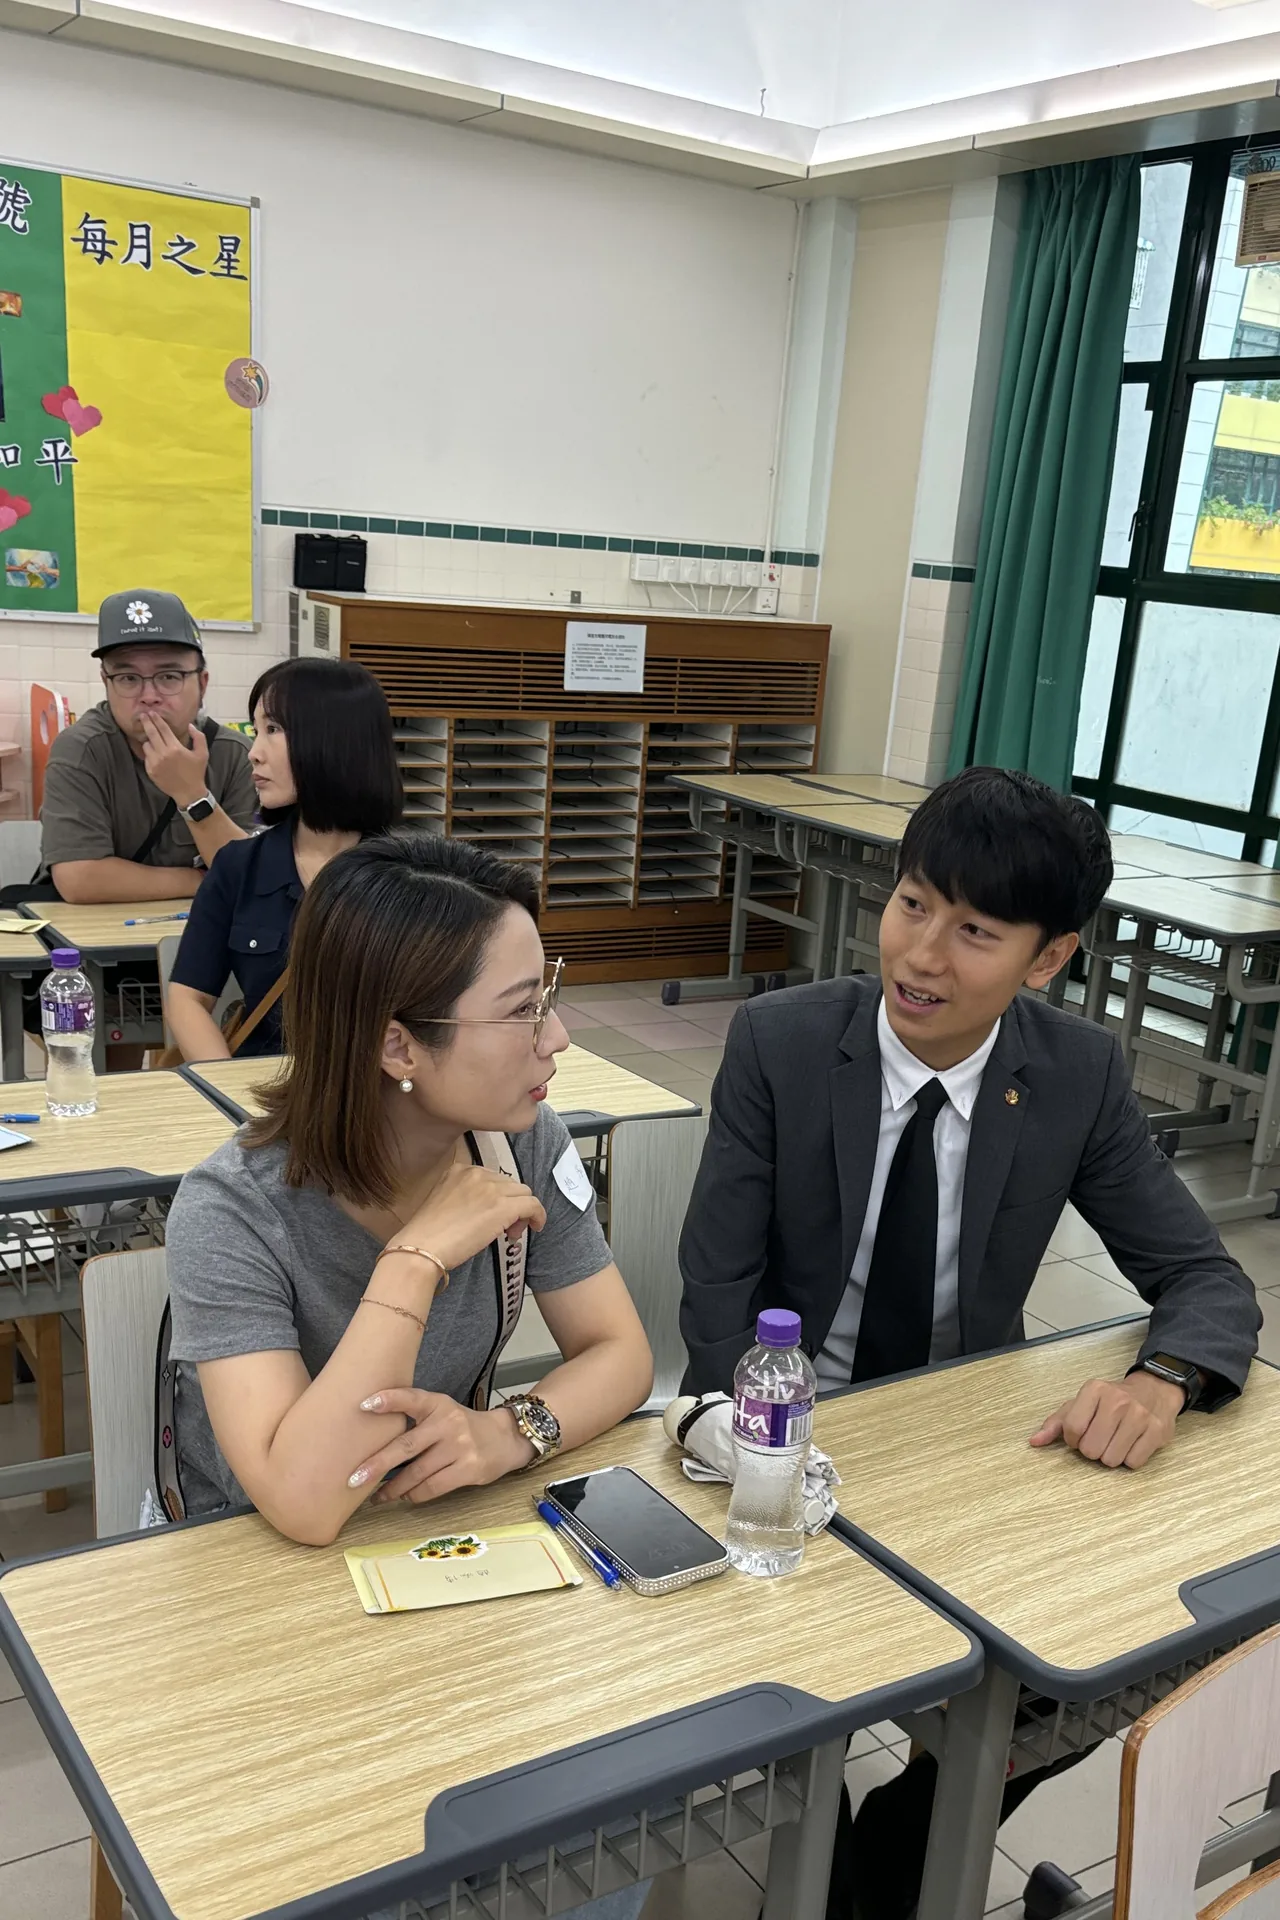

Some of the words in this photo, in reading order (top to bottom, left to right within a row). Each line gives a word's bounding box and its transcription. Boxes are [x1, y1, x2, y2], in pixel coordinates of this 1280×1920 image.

[69, 211, 249, 281] 每月之星
[504, 1230, 522, 1326] VUITTO
